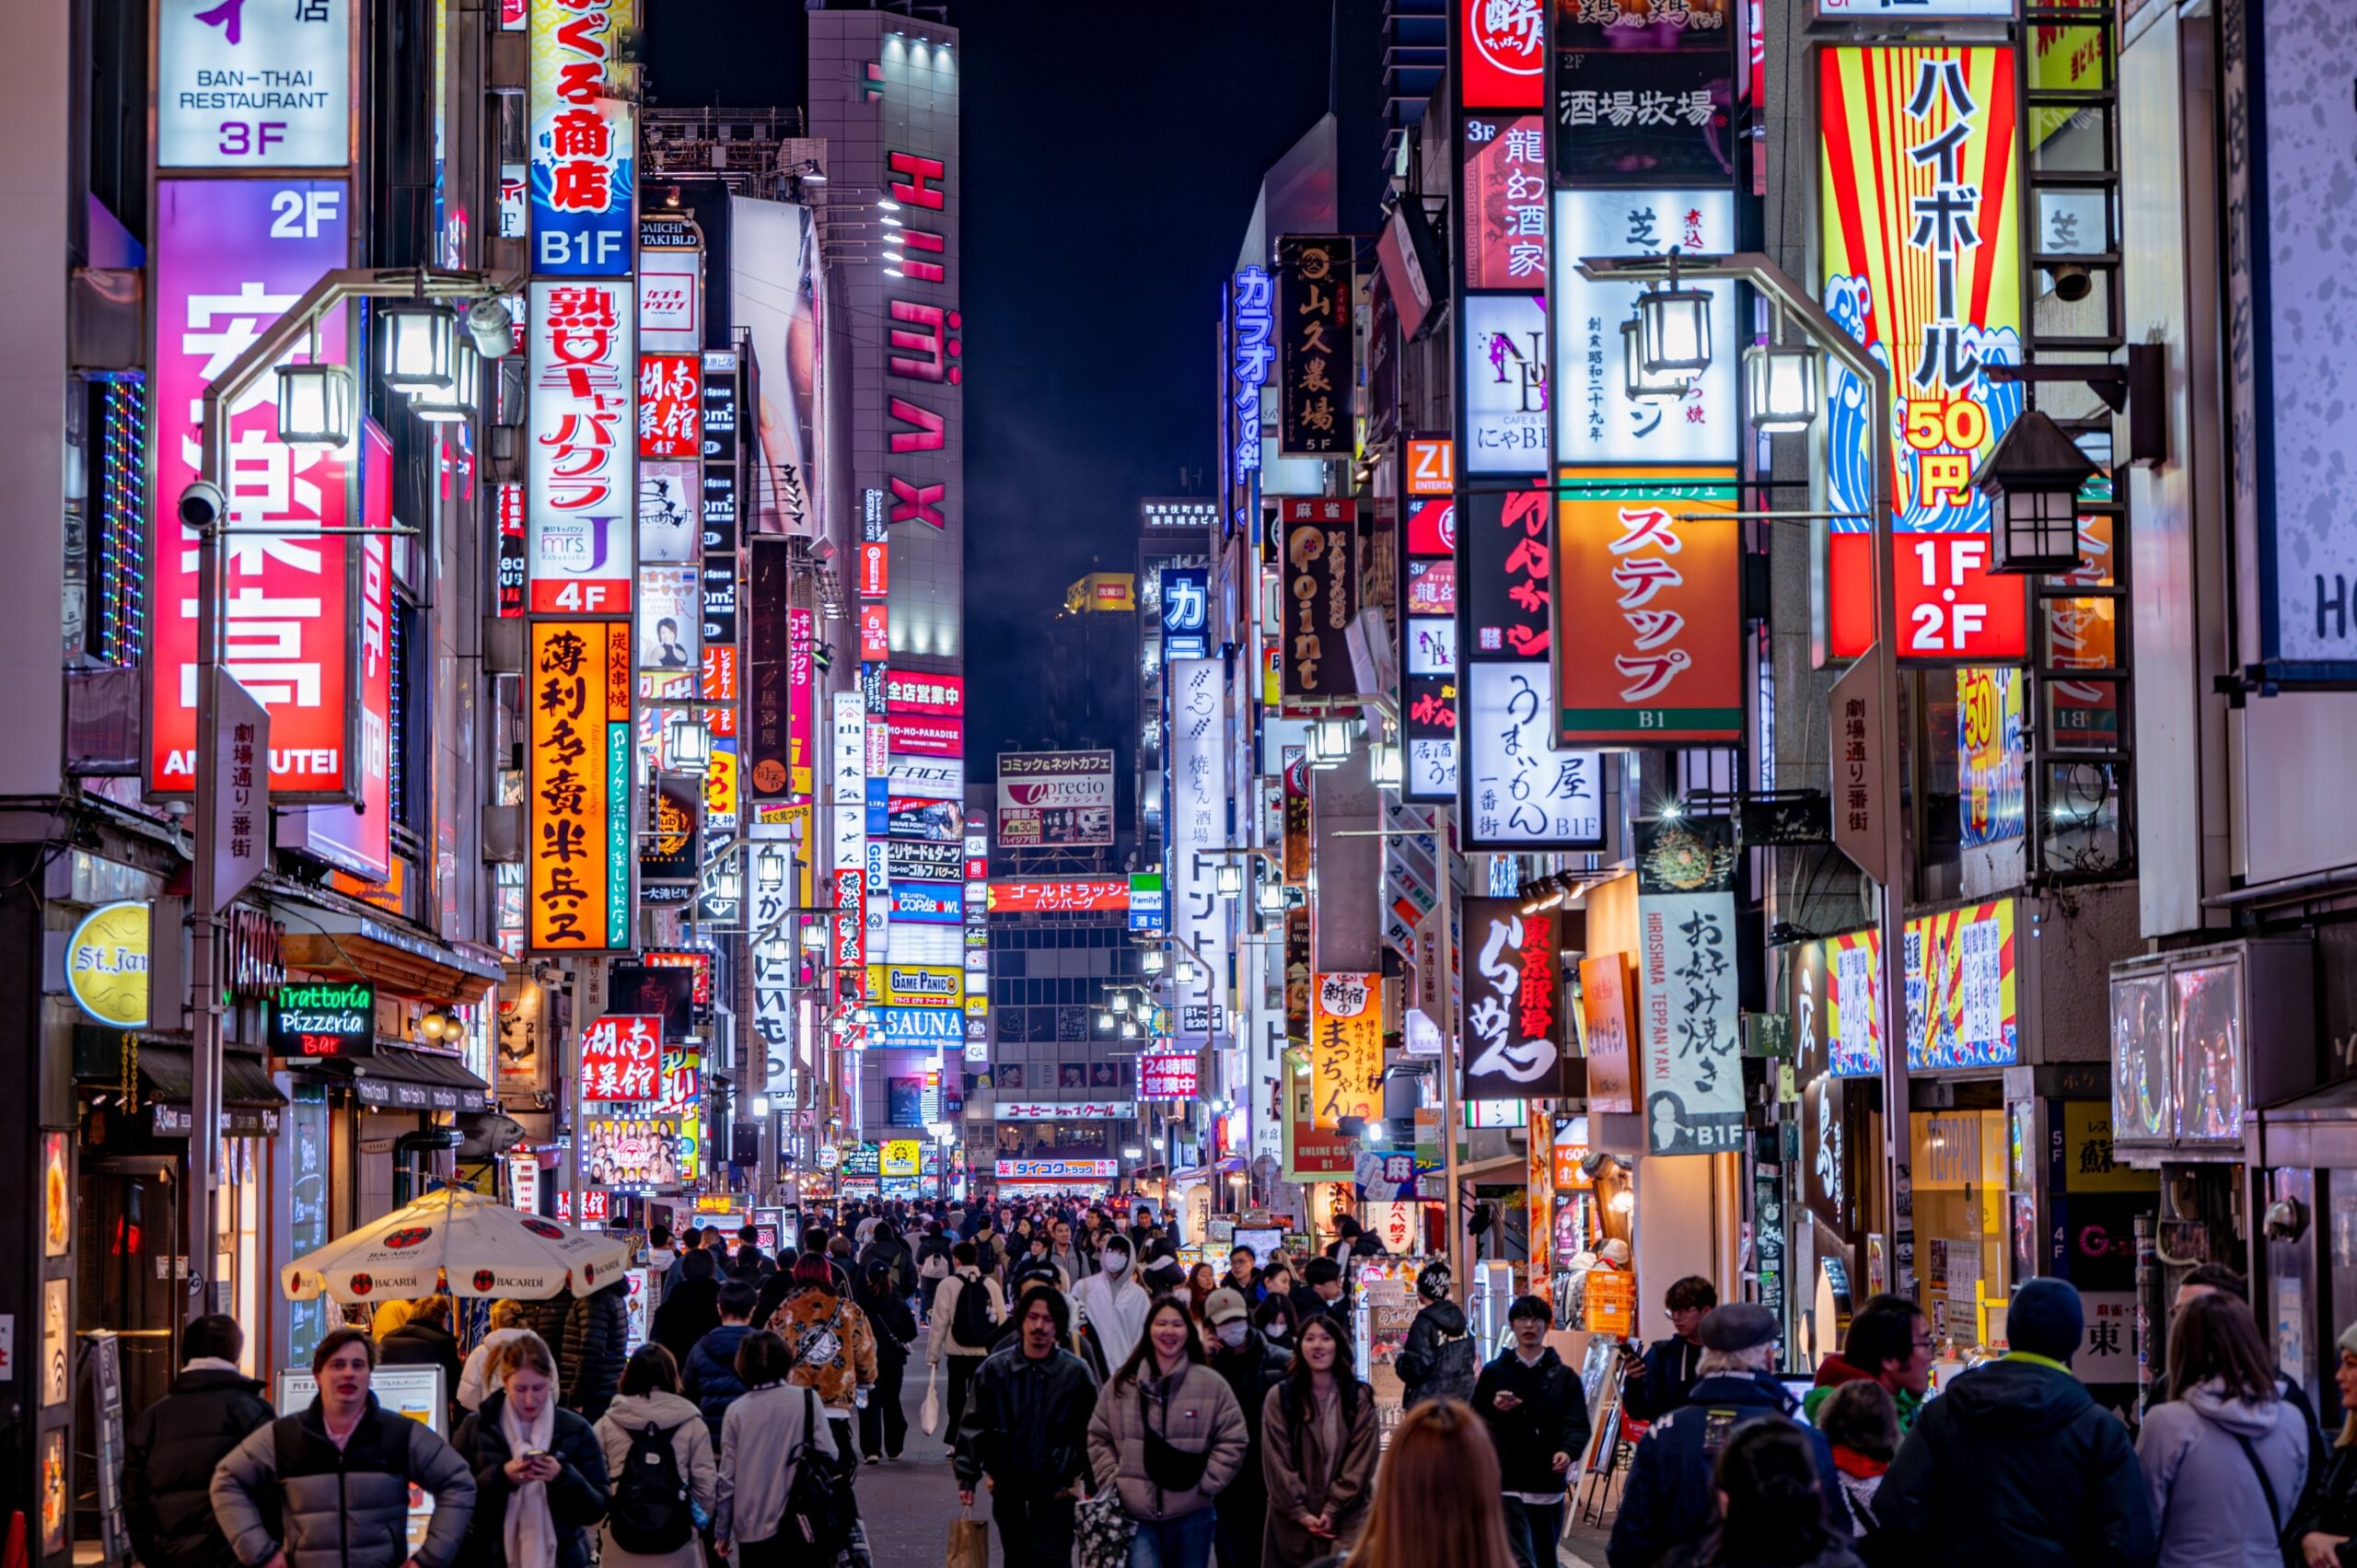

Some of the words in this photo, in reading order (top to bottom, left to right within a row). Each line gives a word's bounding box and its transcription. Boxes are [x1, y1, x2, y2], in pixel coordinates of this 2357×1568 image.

[1564, 54, 1585, 69] 2F
[198, 71, 313, 87] BAN-THAI
[180, 93, 328, 109] RESTAURANT
[1561, 90, 1717, 127] 酒場牧場
[219, 122, 287, 156] 3F
[1468, 121, 1496, 142] 3F
[271, 191, 340, 238] 2F
[1505, 128, 1545, 277] 龍幻酒家
[1683, 208, 1704, 249] 煮込
[1903, 57, 1983, 392] ハイボール
[541, 231, 621, 264] B1F
[1298, 285, 1335, 431] 山久農場
[1587, 317, 1604, 443] 創業昭和二十九年
[539, 287, 628, 511] 熟女キャバクラ
[1905, 399, 1987, 450] 50
[652, 440, 676, 454] 4F
[1306, 438, 1331, 450] 5F
[1415, 445, 1450, 478] ZI
[1919, 453, 1972, 507] 円
[1295, 503, 1341, 518] 麻雀
[1410, 503, 1423, 512] 4F
[1410, 563, 1426, 575] 3F
[1915, 540, 1986, 587] 1F
[555, 583, 606, 611] 4F
[1608, 506, 1692, 703] ステップ
[1910, 603, 1988, 650] 2F
[796, 614, 810, 685] キャバクラ
[609, 632, 629, 708] 炭火串焼
[888, 681, 959, 706] 全店営業中
[1638, 711, 1666, 728] B1
[163, 749, 338, 774] AUTEI
[877, 733, 885, 769] カラオケ
[1003, 757, 1110, 772] コミック&ネットカフェ
[1286, 749, 1301, 761] 3F
[1414, 742, 1452, 760] 居酒
[888, 765, 959, 781] FACE
[1844, 698, 1869, 832] 劇場通り一番街
[230, 724, 255, 858] 劇場通り一番街
[1053, 796, 1103, 804] アプレシオ
[1479, 776, 1500, 837] 一番街
[709, 815, 735, 826] 天神
[1555, 817, 1597, 837] B1F
[1002, 835, 1040, 844] ハイジアB1
[868, 844, 881, 888] GiGO
[935, 865, 960, 878] バグース
[640, 887, 690, 900] 一大滝ビル
[1036, 897, 1096, 909] ハンバーグ
[1132, 896, 1161, 906] Family
[1136, 915, 1148, 928] 酒
[1647, 912, 1665, 985] HIROSHIMA
[587, 956, 600, 1005] 通り一番街
[891, 969, 918, 990] GAME
[920, 969, 947, 993] PANIC
[1520, 914, 1552, 1040] 東京豚骨
[279, 983, 370, 1010] Trattoria
[1322, 981, 1364, 1016] 新宿の
[1673, 910, 1736, 1094] お好み焼き
[281, 1012, 364, 1035] Pizzeria
[886, 1010, 963, 1037] SAUNA
[301, 1034, 343, 1056] Bar
[1145, 1060, 1196, 1075] 24時間
[1320, 1018, 1353, 1119] まっちゃん
[1144, 1077, 1196, 1094] 営業中
[1008, 1104, 1051, 1117] コーヒー
[1083, 1104, 1115, 1117] クール
[1697, 1125, 1743, 1146] B1F
[2052, 1130, 2062, 1164] 5F
[1299, 1146, 1338, 1156] ONLINE
[1929, 1117, 1981, 1182] TEPPAN
[1321, 1158, 1334, 1170] B1
[1415, 1160, 1442, 1170] フリー
[1389, 1201, 1407, 1244] なべ餃子
[2053, 1226, 2064, 1259] 4F
